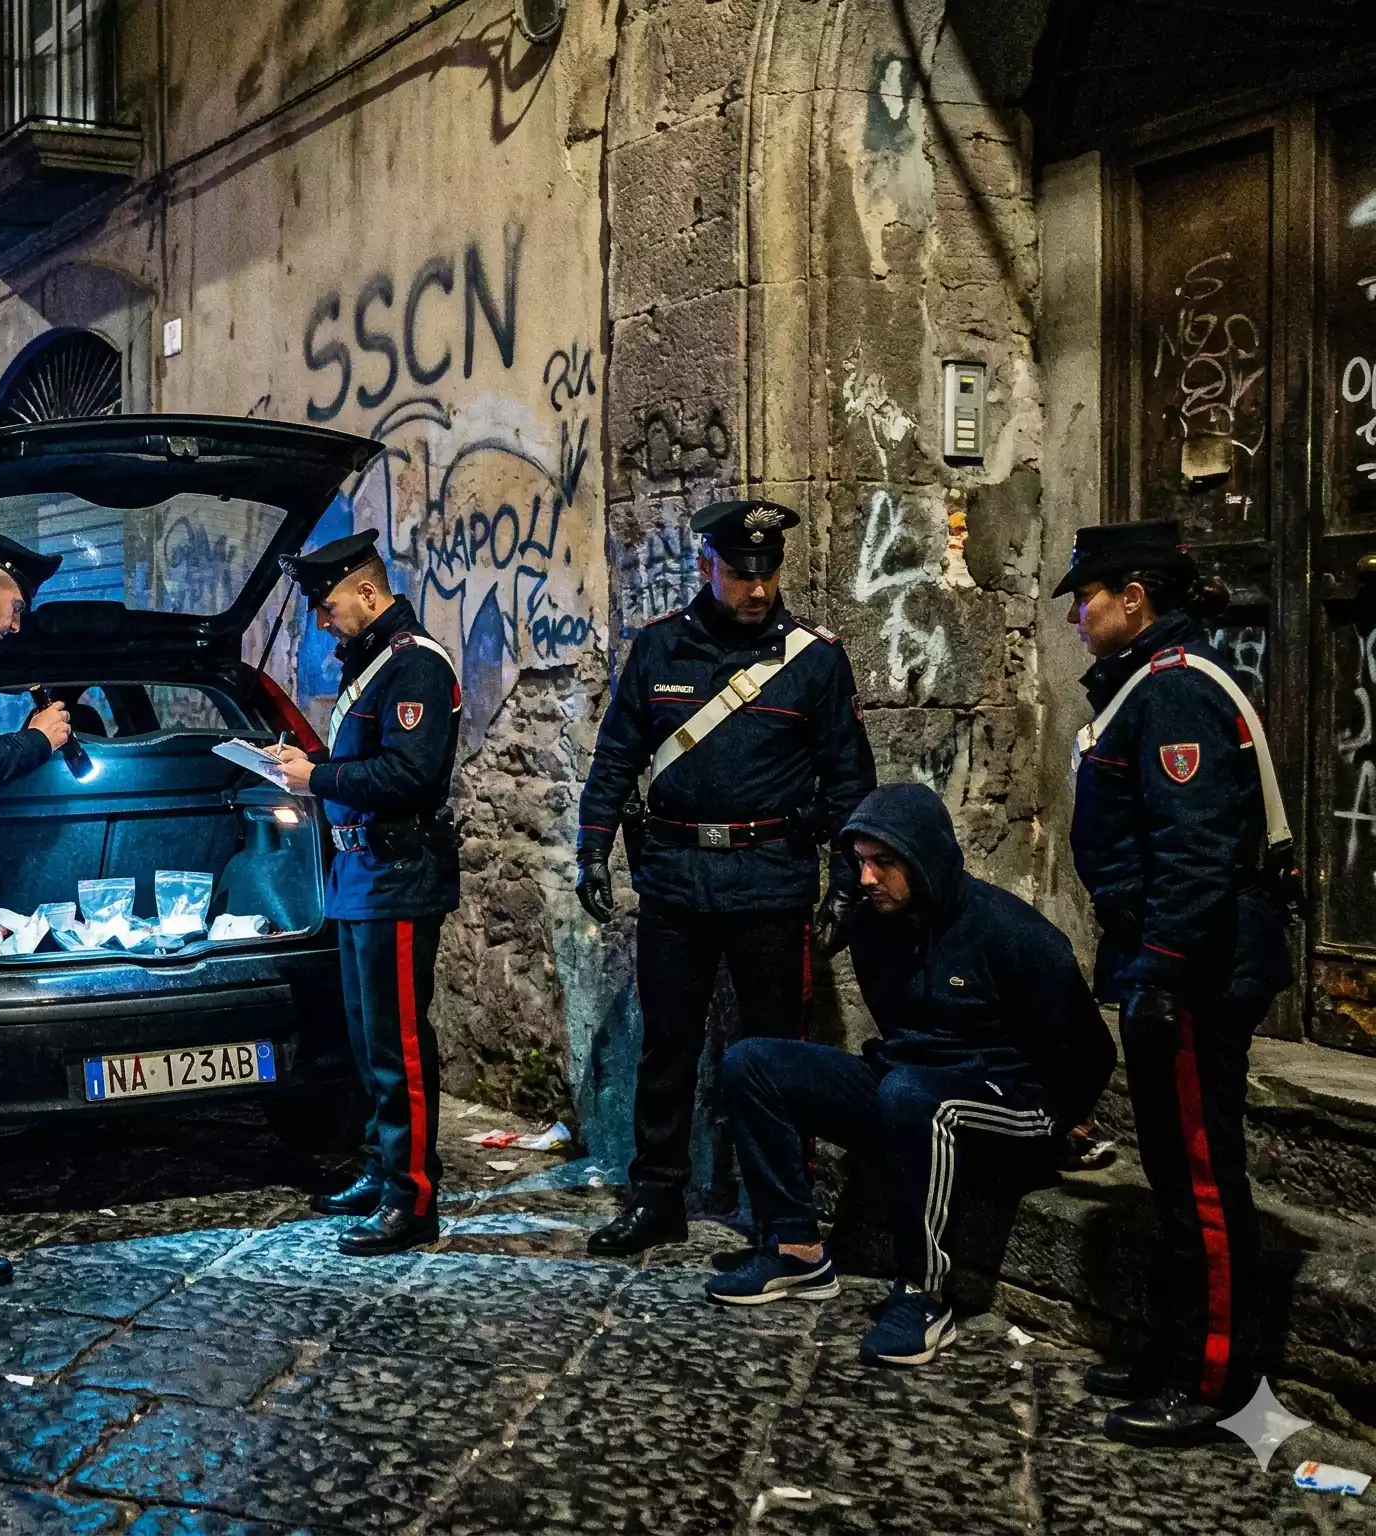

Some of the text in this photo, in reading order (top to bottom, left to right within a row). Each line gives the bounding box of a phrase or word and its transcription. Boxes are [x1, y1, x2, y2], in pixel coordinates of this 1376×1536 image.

[303, 220, 524, 421] SSCN
[108, 1056, 148, 1093] NA
[163, 1046, 254, 1087] 123AB
